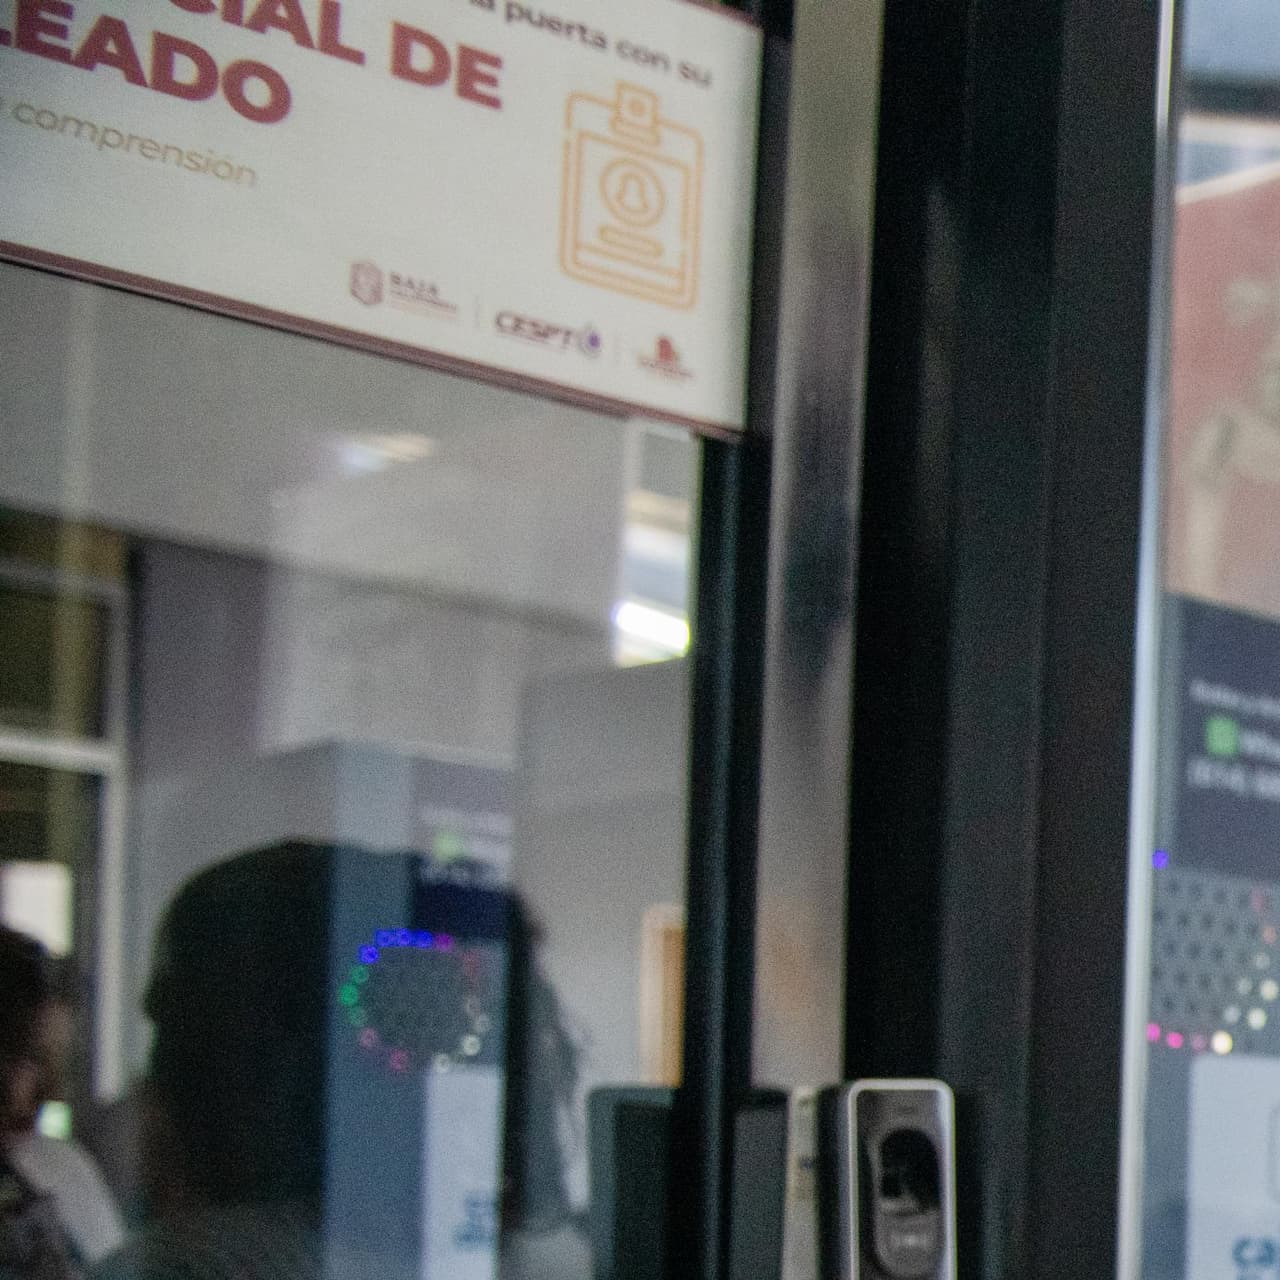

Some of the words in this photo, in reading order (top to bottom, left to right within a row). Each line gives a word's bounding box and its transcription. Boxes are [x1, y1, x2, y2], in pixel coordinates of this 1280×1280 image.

[0, 0, 292, 124] EADO
[389, 20, 503, 110] DE
[504, 1, 608, 50] puerta
[615, 39, 671, 72] con
[677, 59, 714, 88] su
[11, 100, 259, 187] comprensión
